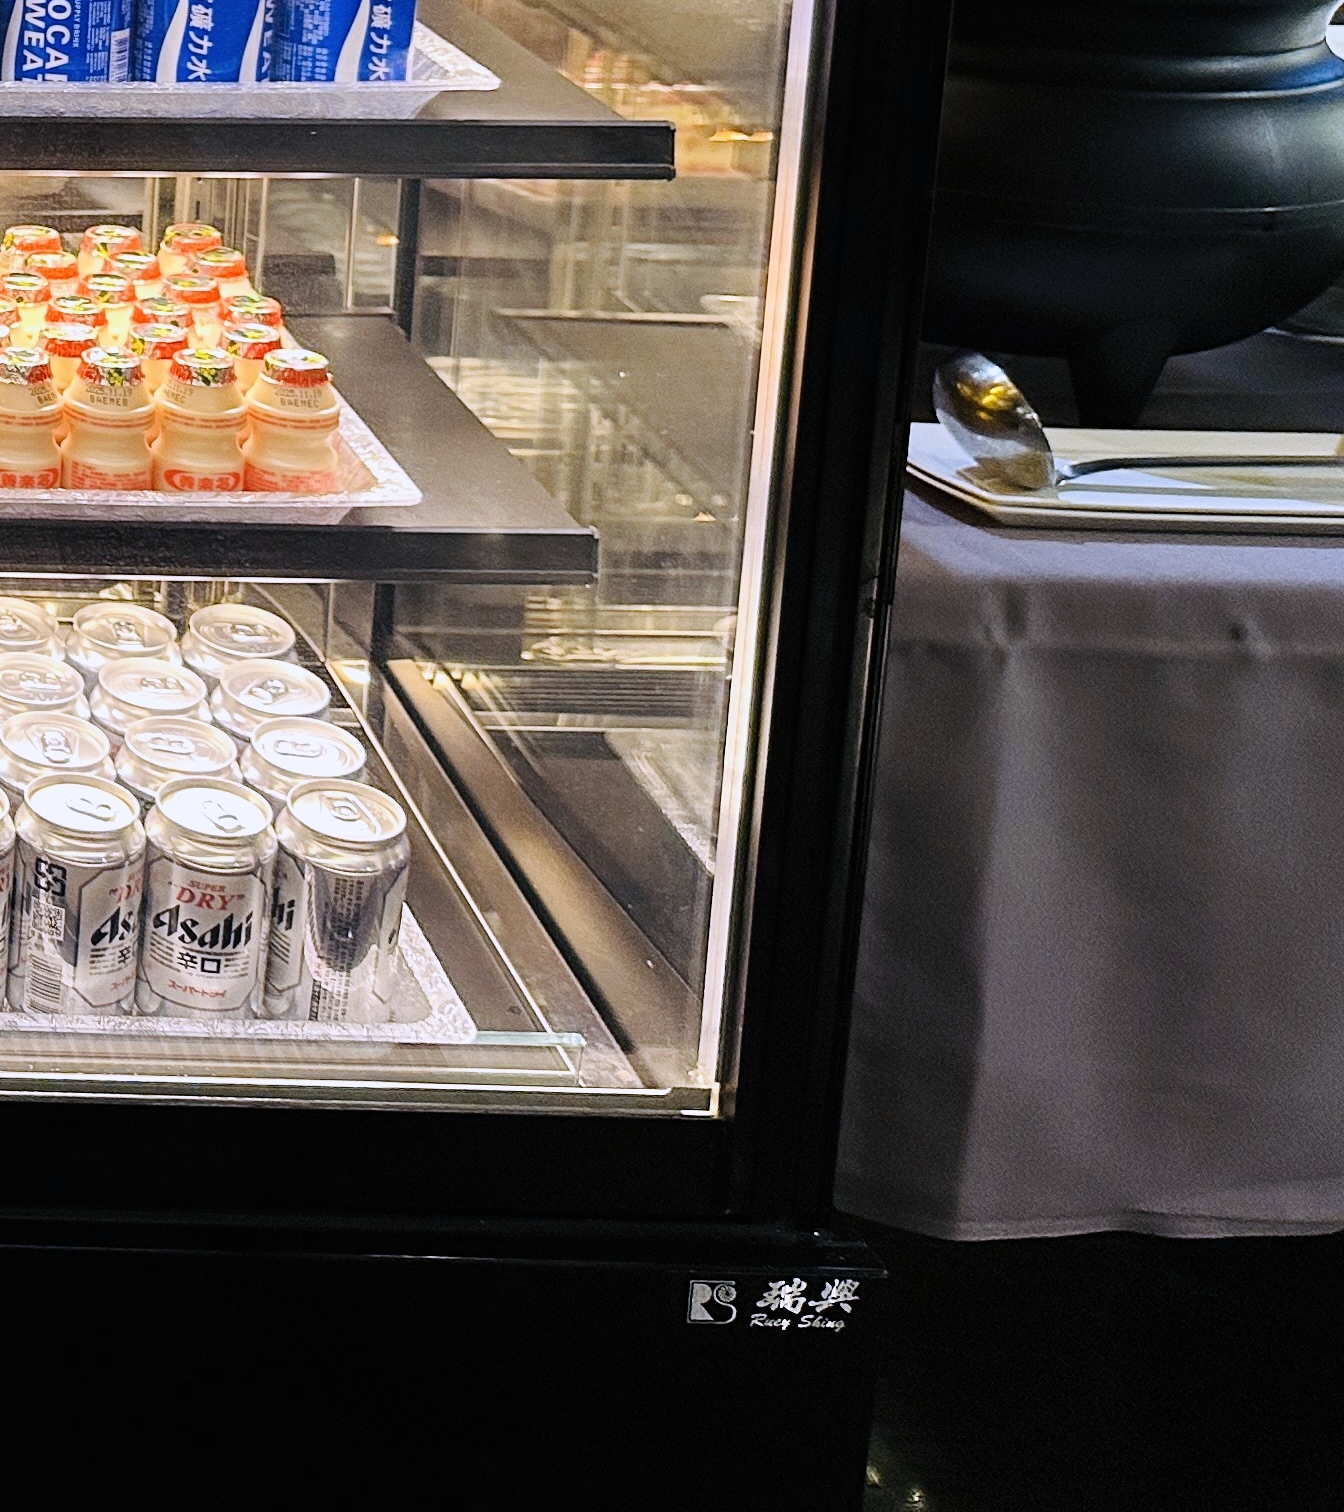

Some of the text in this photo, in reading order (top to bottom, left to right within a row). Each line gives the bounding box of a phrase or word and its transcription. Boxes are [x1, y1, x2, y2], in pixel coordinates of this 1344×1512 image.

[189, 880, 226, 891] SUPER
[152, 904, 253, 951] Asahi
[177, 952, 221, 973] 辛口
[798, 1314, 845, 1332] Shing
